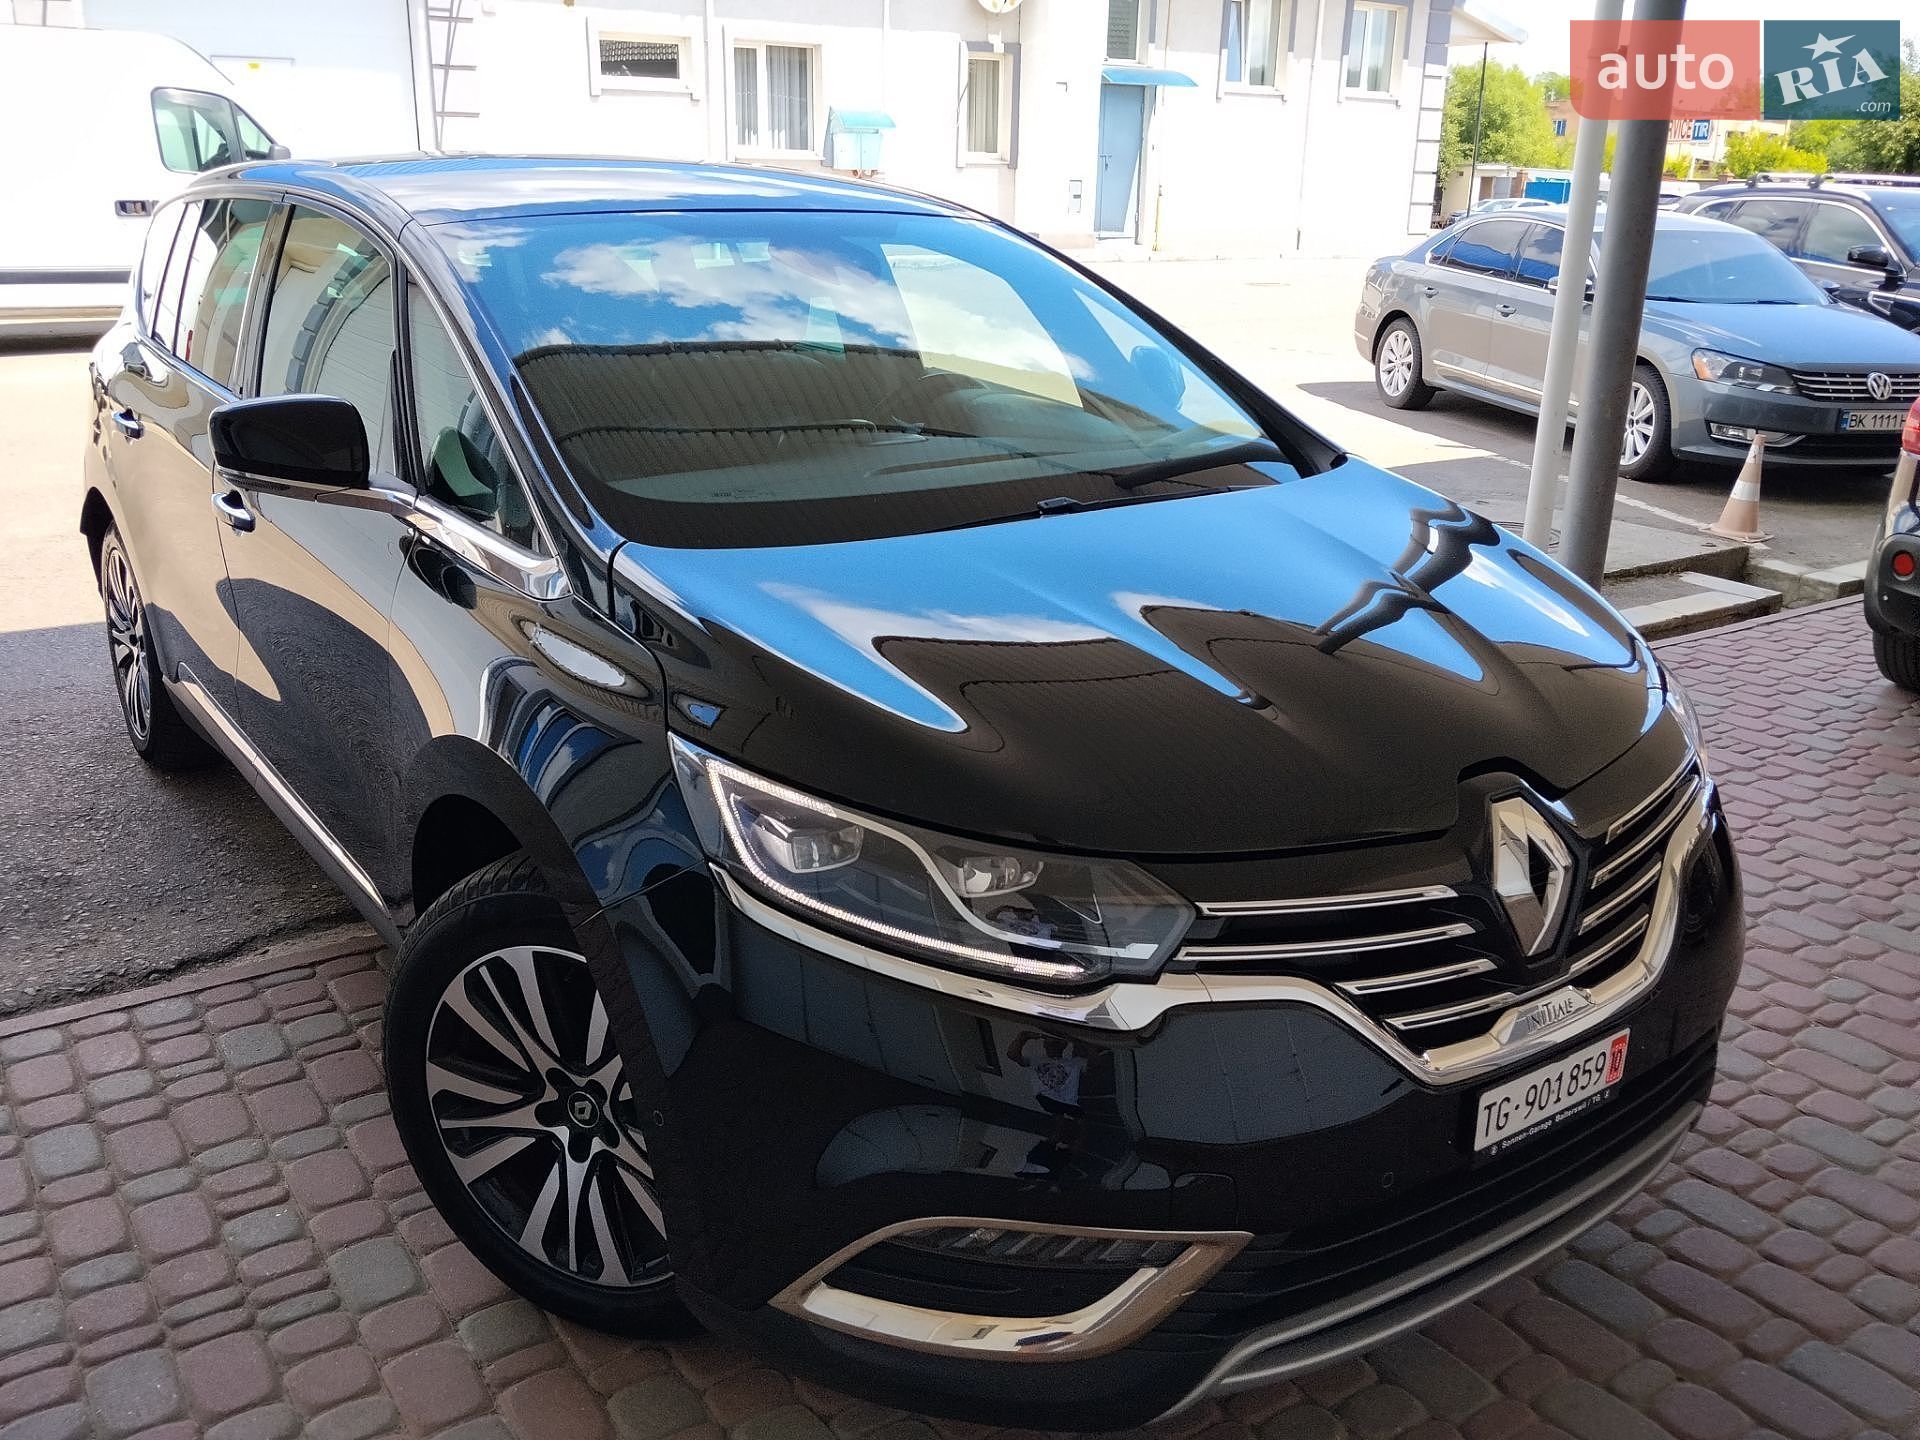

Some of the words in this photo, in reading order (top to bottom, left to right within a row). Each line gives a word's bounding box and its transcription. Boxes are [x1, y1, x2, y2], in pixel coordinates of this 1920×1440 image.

[1694, 121, 1709, 138] TIR
[1849, 414, 1867, 428] BK
[1871, 414, 1898, 428] 1111
